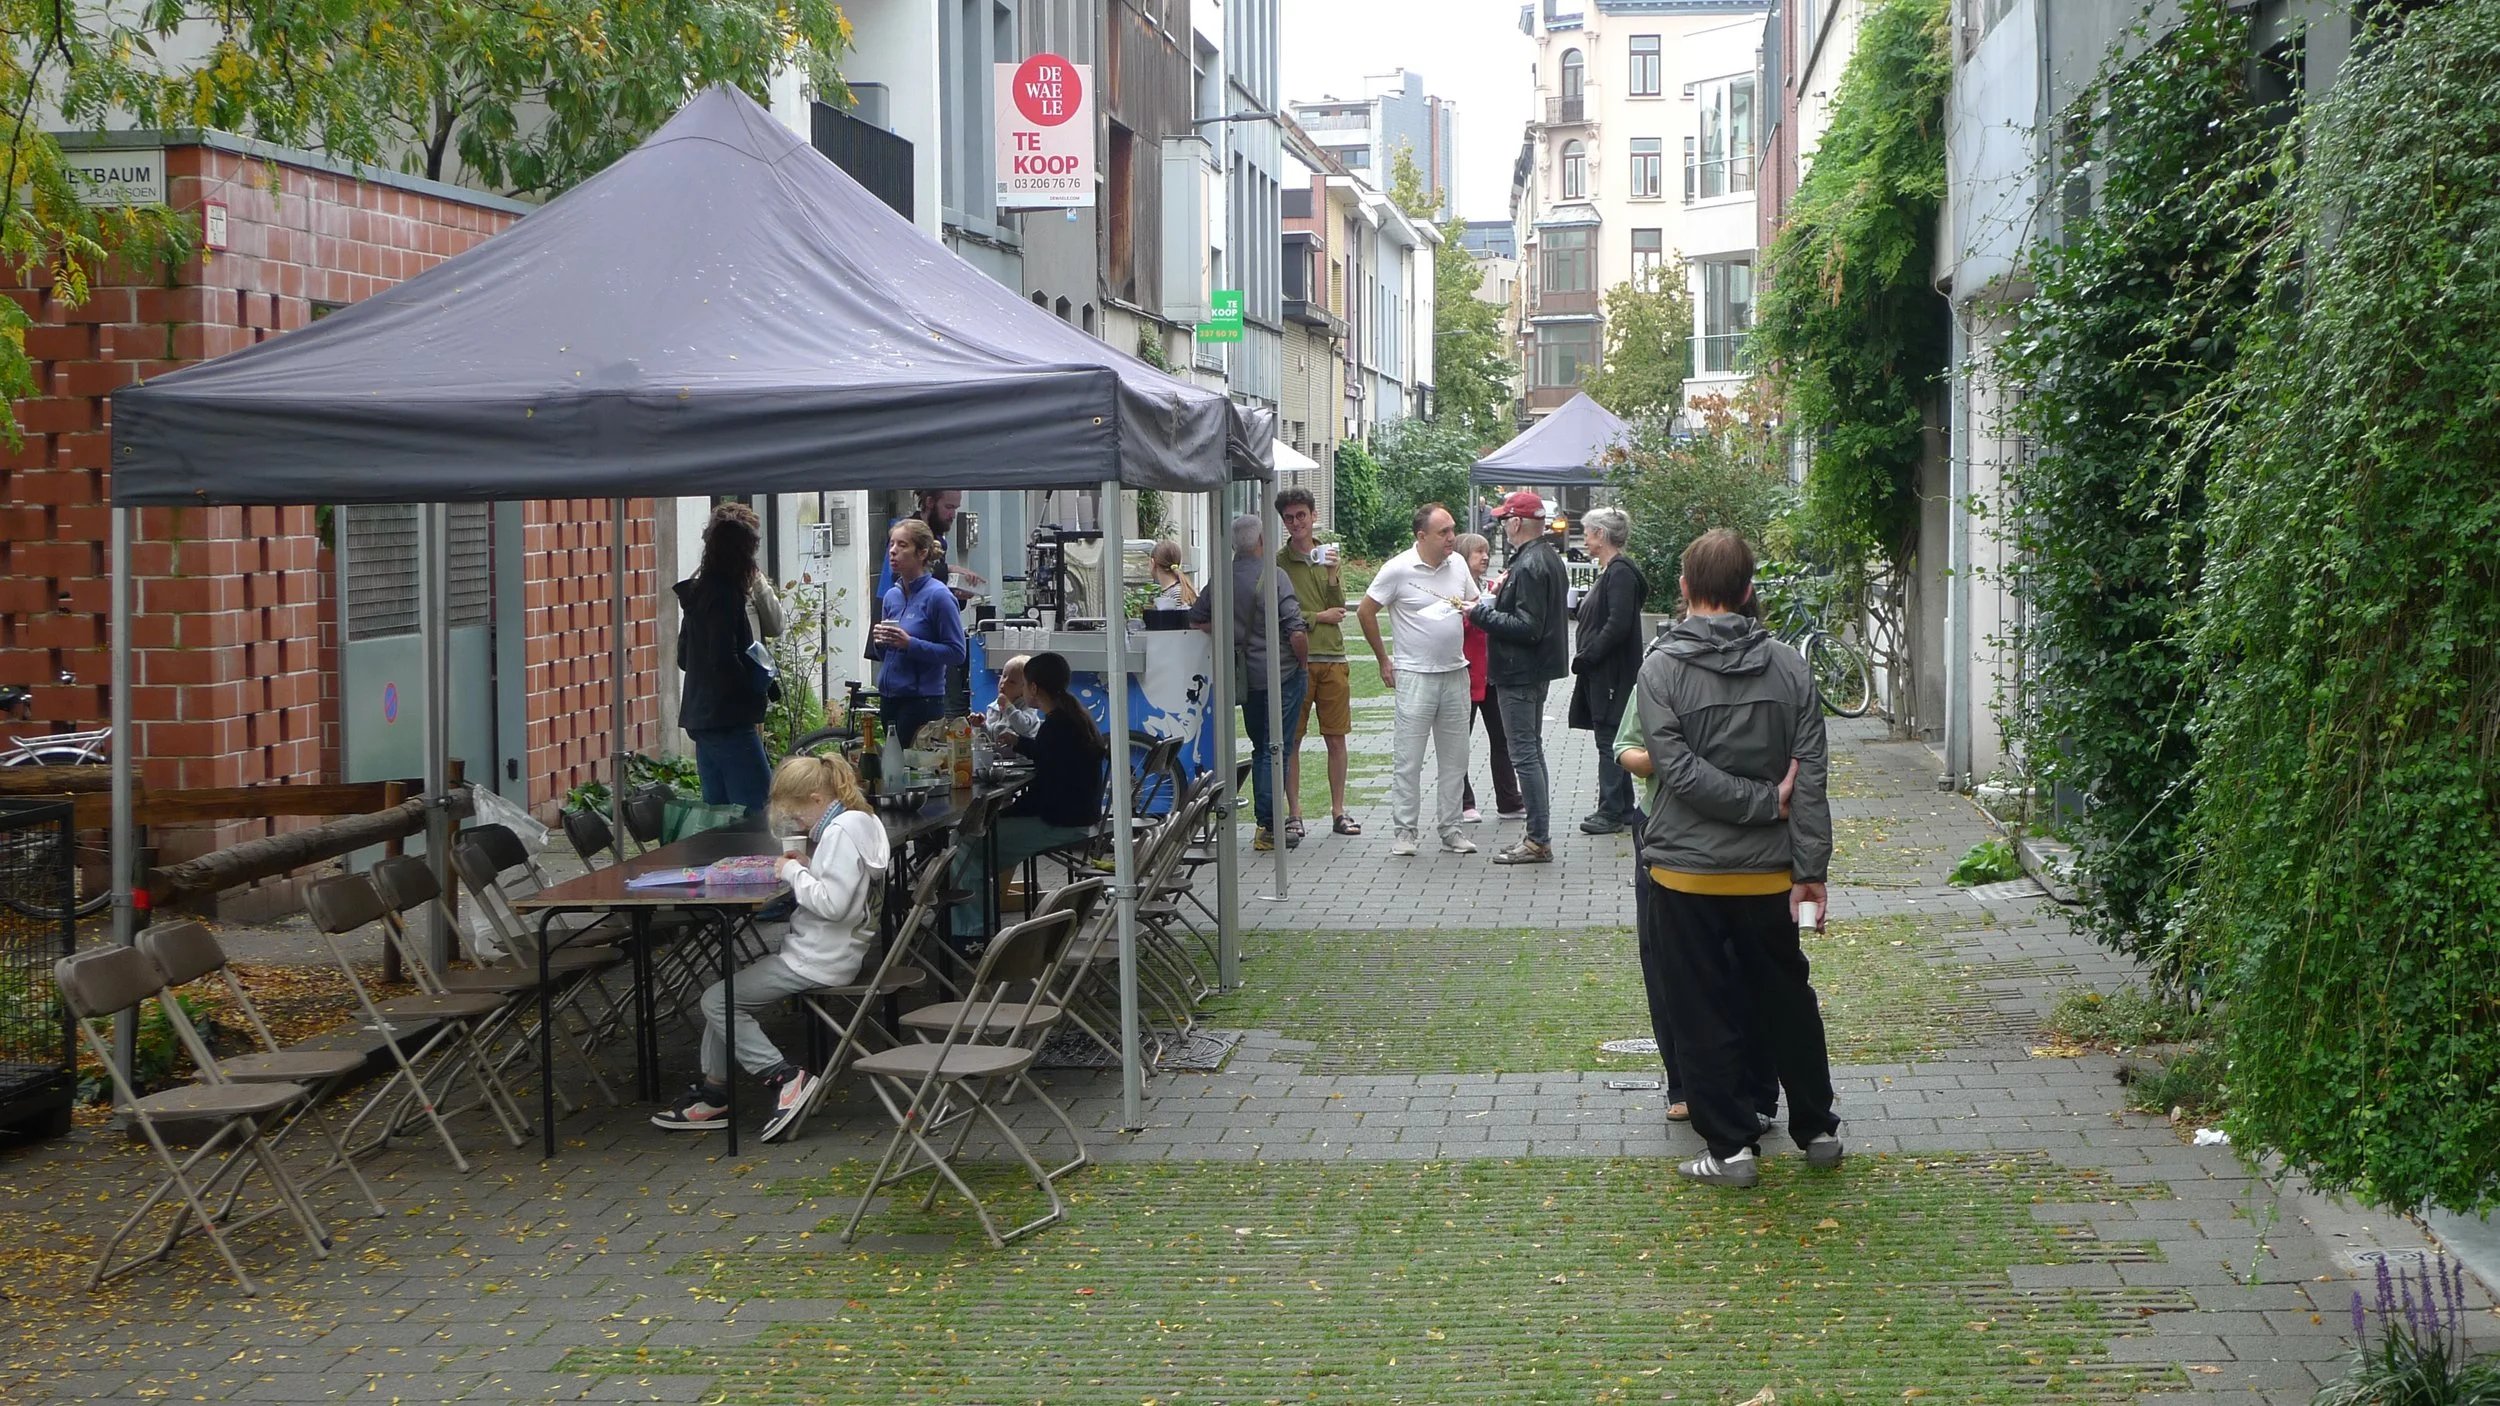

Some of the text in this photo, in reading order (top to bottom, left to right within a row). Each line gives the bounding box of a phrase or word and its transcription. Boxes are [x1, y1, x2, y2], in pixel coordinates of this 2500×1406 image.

[1039, 66, 1062, 82] DE
[1025, 82, 1063, 99] WAE
[1041, 100, 1063, 116] LE
[1012, 132, 1041, 151] TE
[1014, 155, 1079, 175] KOOP
[1014, 178, 1081, 189] 03 206 76 76
[1226, 300, 1238, 308] TE
[1211, 308, 1238, 317] KOOP
